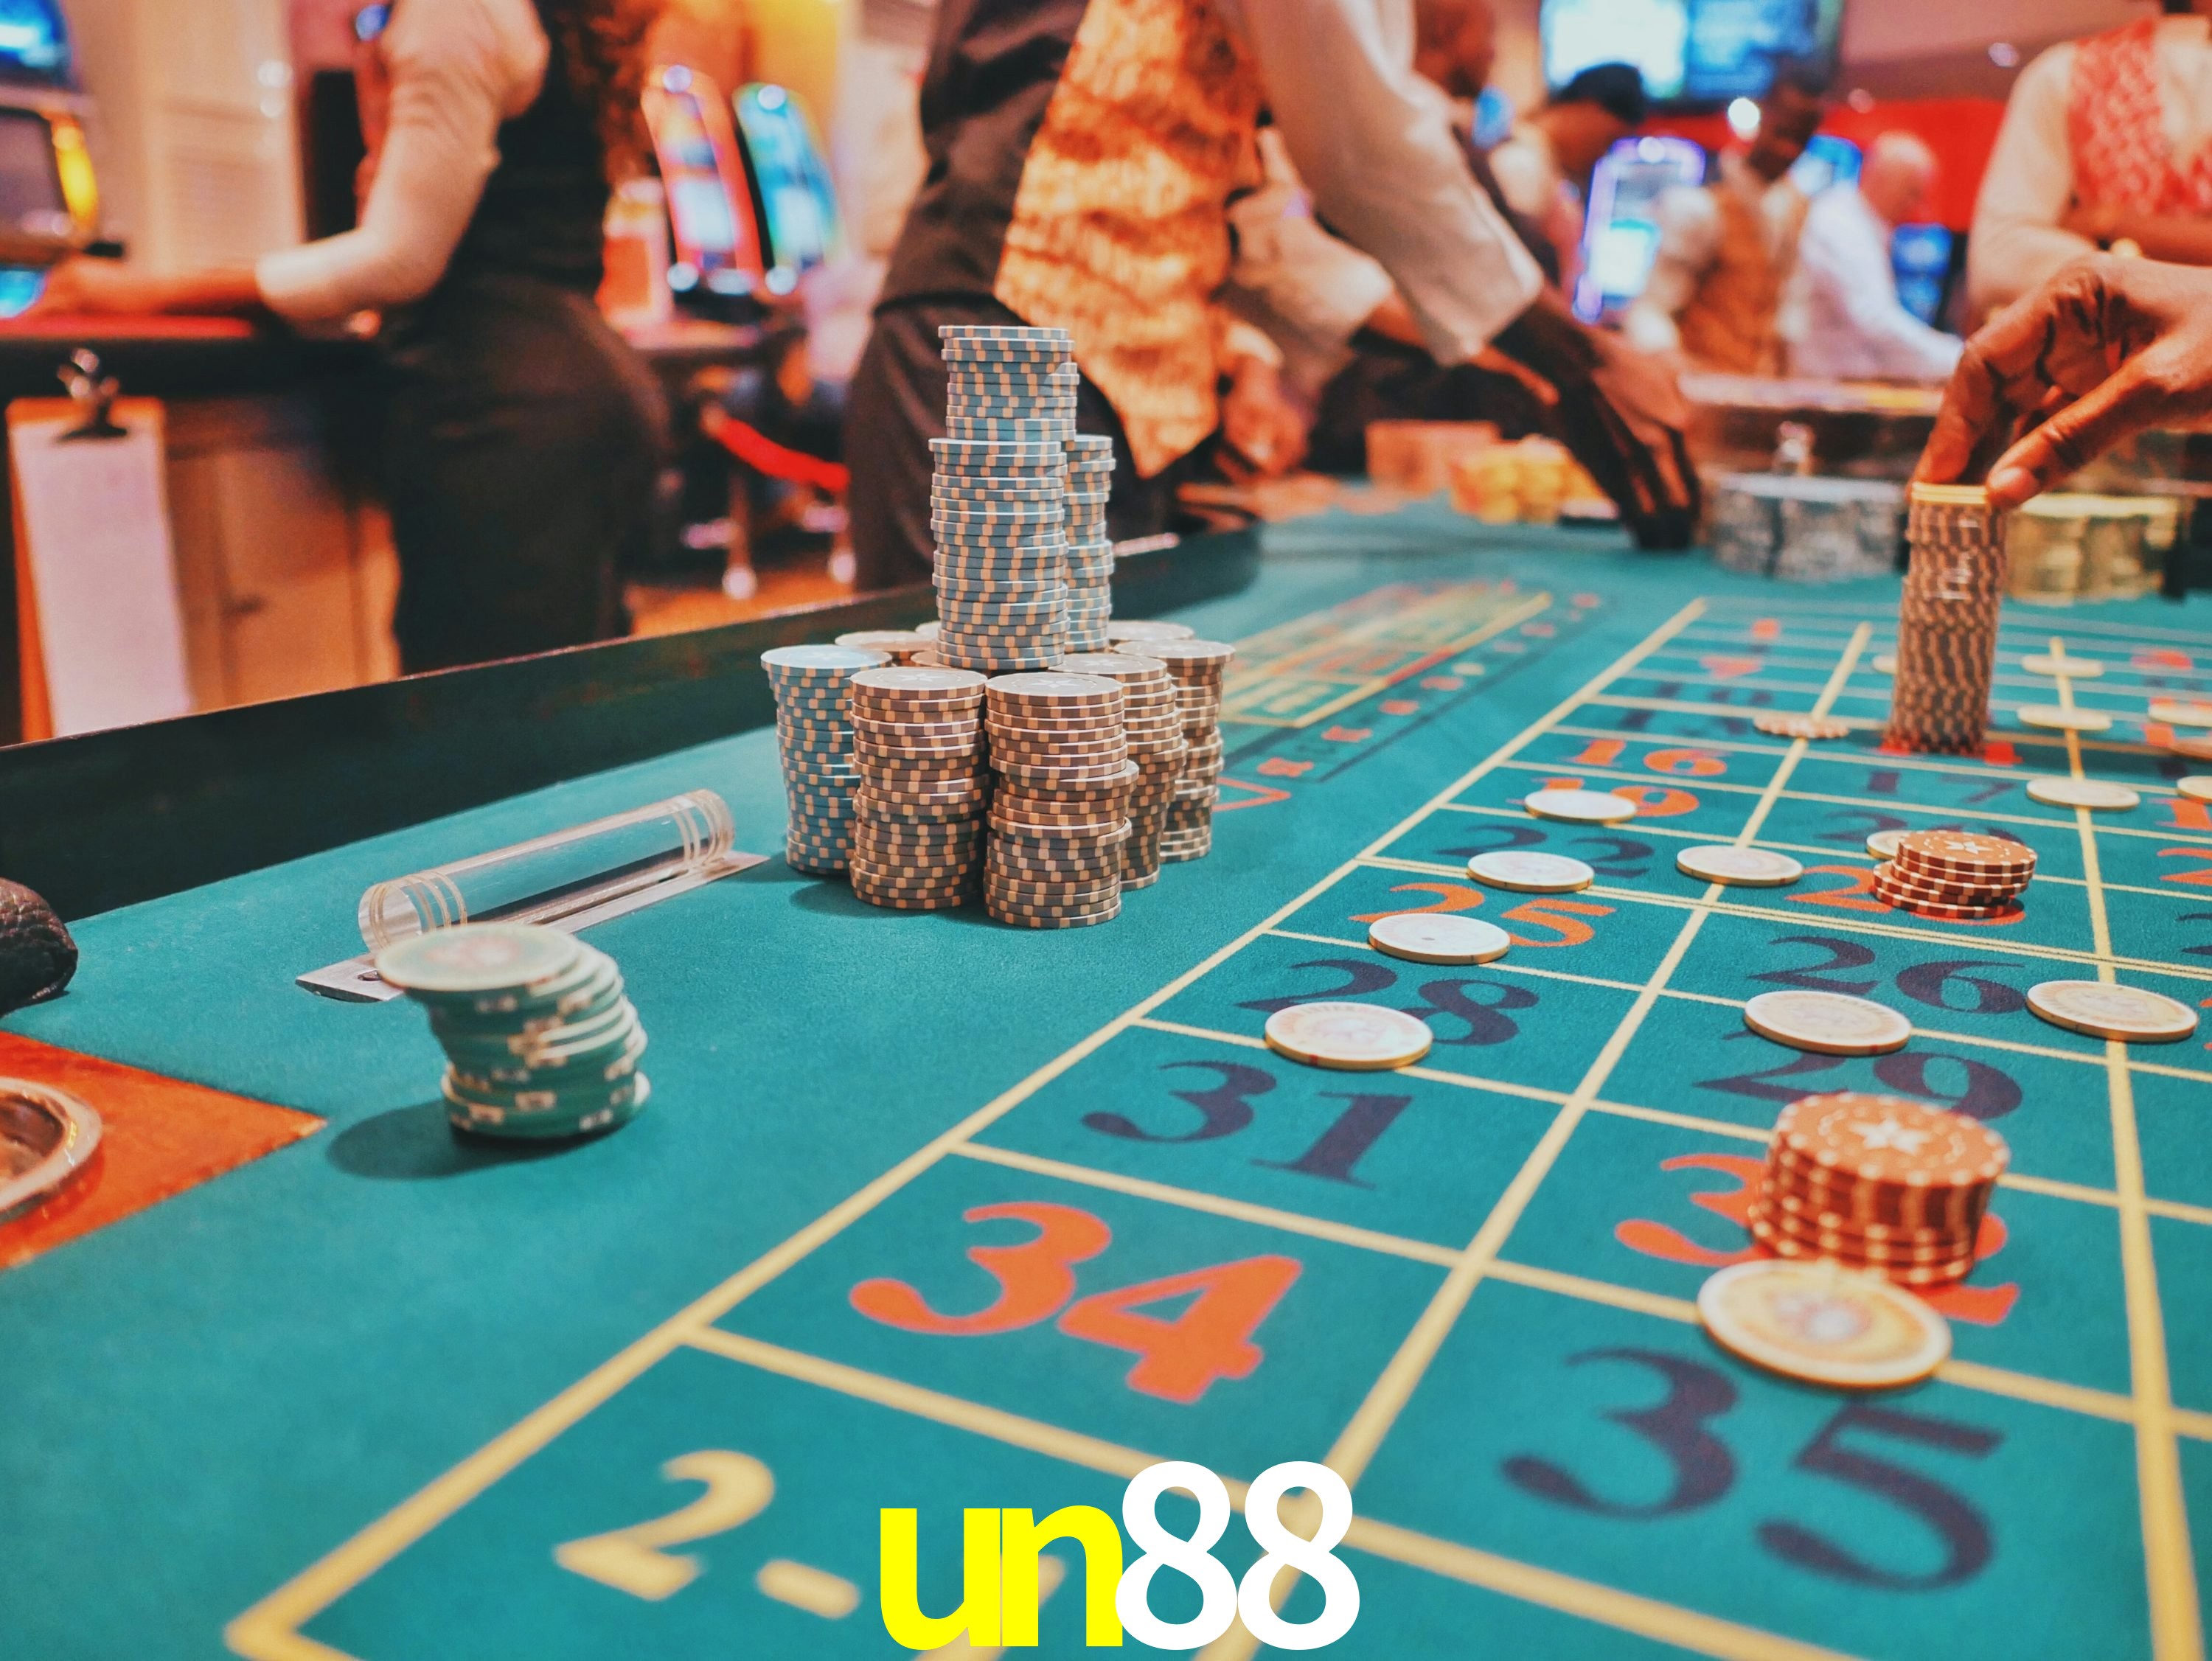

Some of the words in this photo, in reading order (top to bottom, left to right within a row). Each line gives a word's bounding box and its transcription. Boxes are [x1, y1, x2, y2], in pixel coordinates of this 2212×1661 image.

[1565, 738, 1730, 776] 16
[1865, 770, 2017, 804] 17
[1349, 883, 1617, 947] 25
[1234, 959, 1540, 1046] 28
[1747, 936, 2027, 1014] 26
[1693, 1031, 2023, 1120] 29
[1081, 1060, 1414, 1190] 31
[849, 1201, 1302, 1404] 34
[1500, 1347, 2004, 1594] 35
